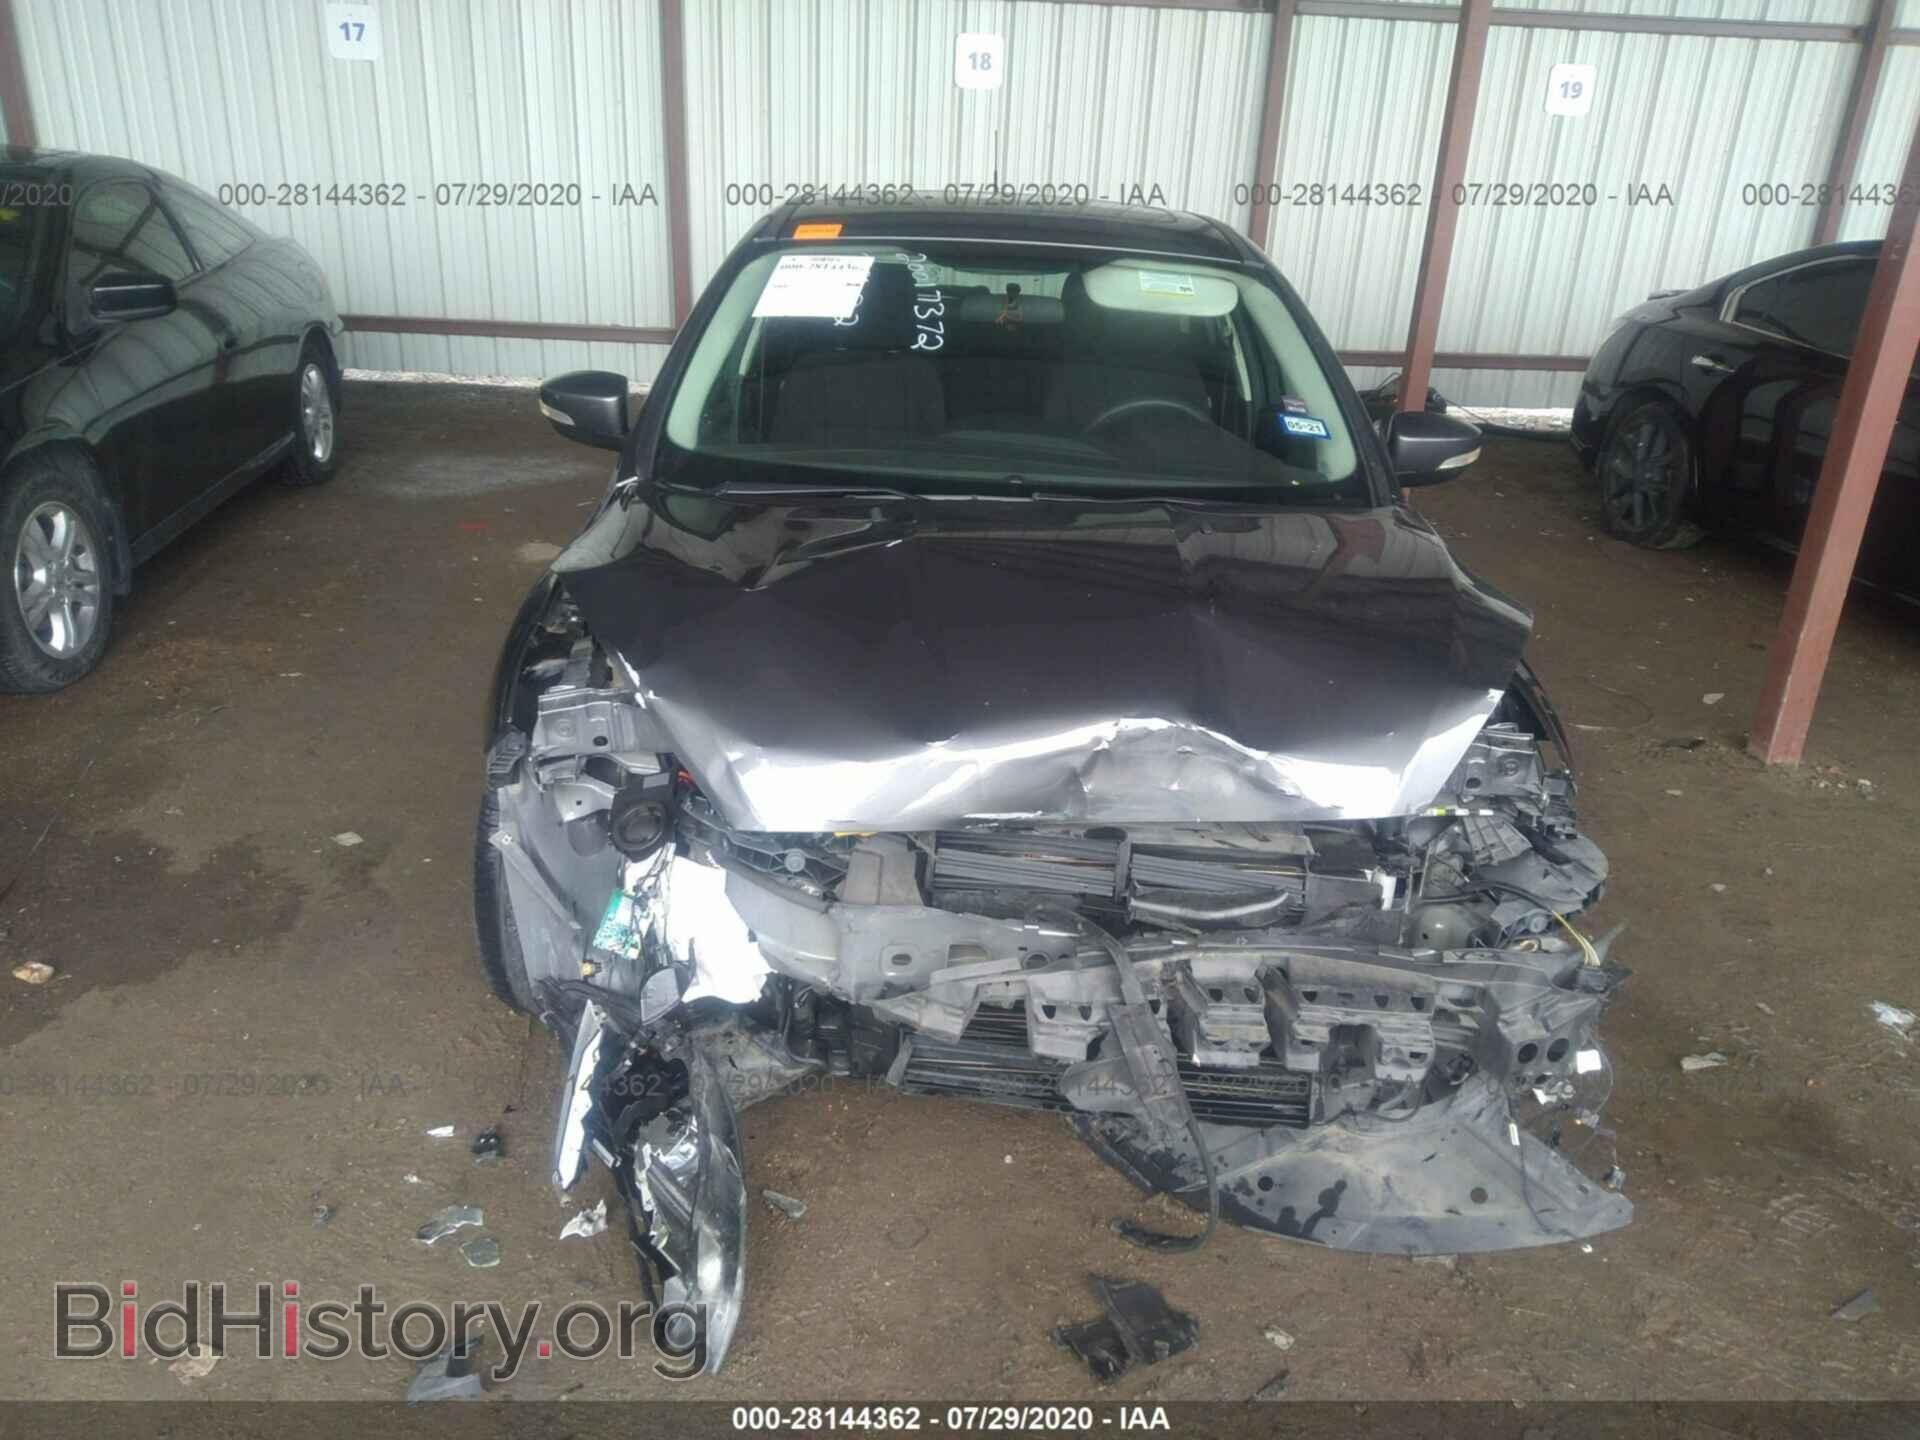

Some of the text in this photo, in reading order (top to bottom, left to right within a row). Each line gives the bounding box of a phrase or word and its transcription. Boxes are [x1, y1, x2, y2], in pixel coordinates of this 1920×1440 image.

[339, 22, 365, 41] 17
[969, 52, 992, 70] 18
[1560, 81, 1583, 99] 19
